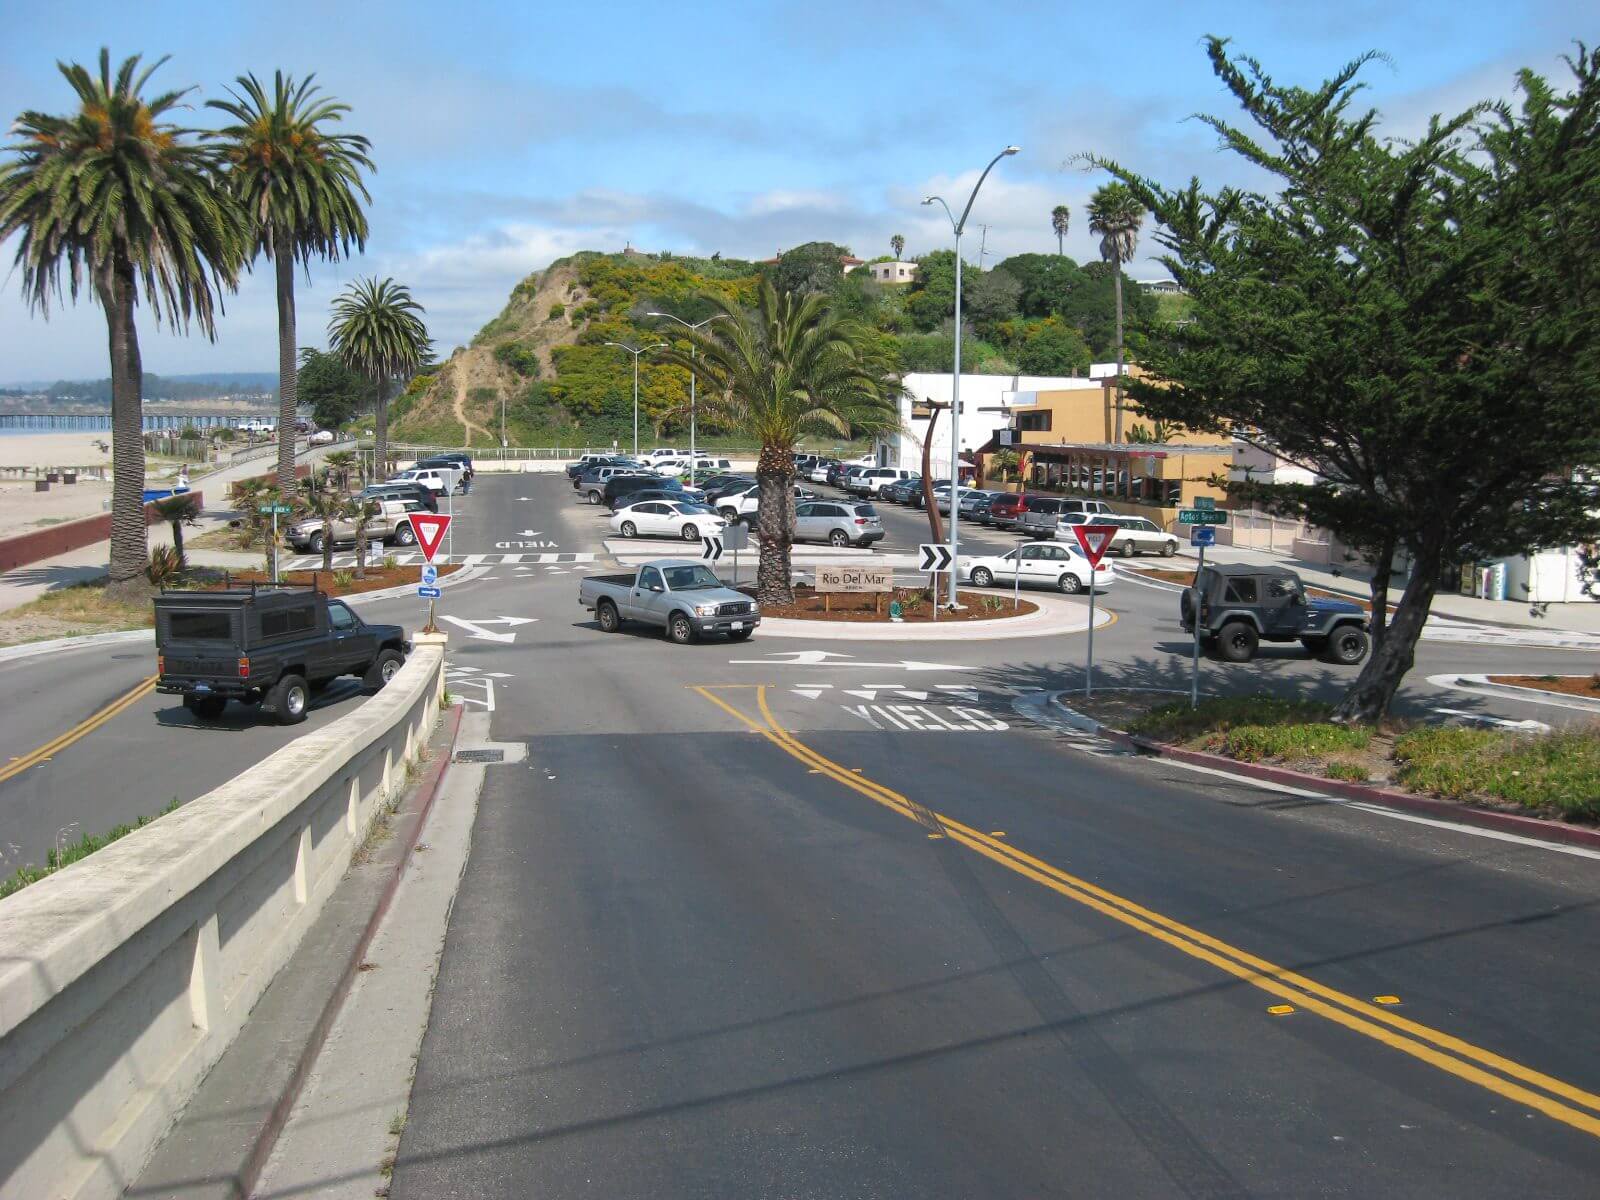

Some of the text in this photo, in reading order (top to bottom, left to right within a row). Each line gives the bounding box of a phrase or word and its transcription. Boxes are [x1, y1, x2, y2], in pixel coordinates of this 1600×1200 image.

[1180, 512, 1199, 522] Aptos
[495, 540, 559, 549] YIELD
[823, 573, 885, 585] Rio Del Mar
[839, 705, 1010, 731] YIELD
